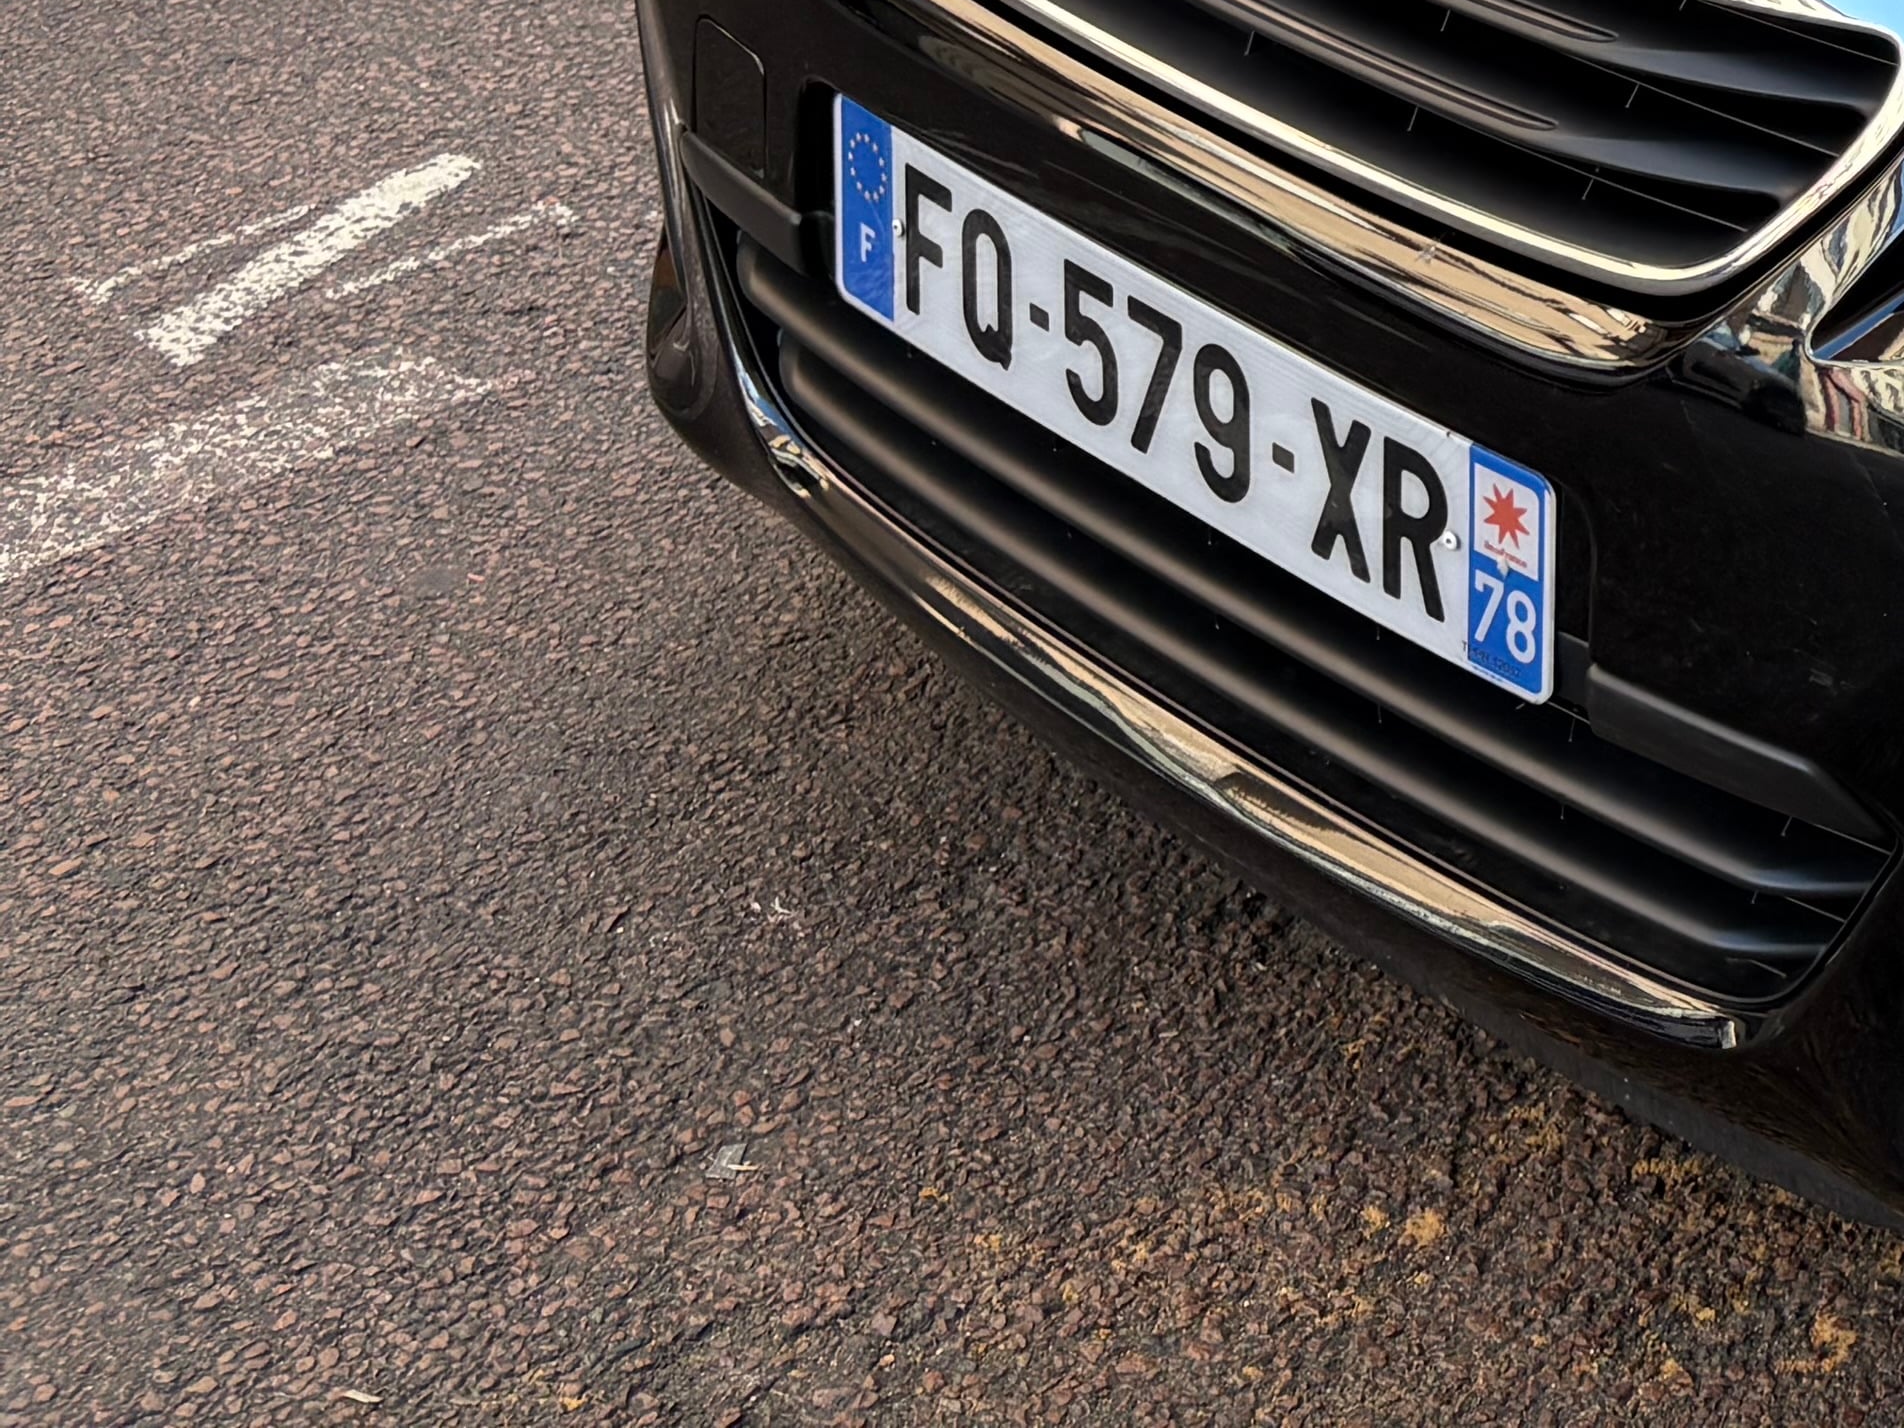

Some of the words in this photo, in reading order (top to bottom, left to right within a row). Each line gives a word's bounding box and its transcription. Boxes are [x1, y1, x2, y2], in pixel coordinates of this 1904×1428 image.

[860, 226, 877, 263] F
[905, 162, 1450, 624] FQ-579-XR
[1474, 569, 1537, 665] 78
